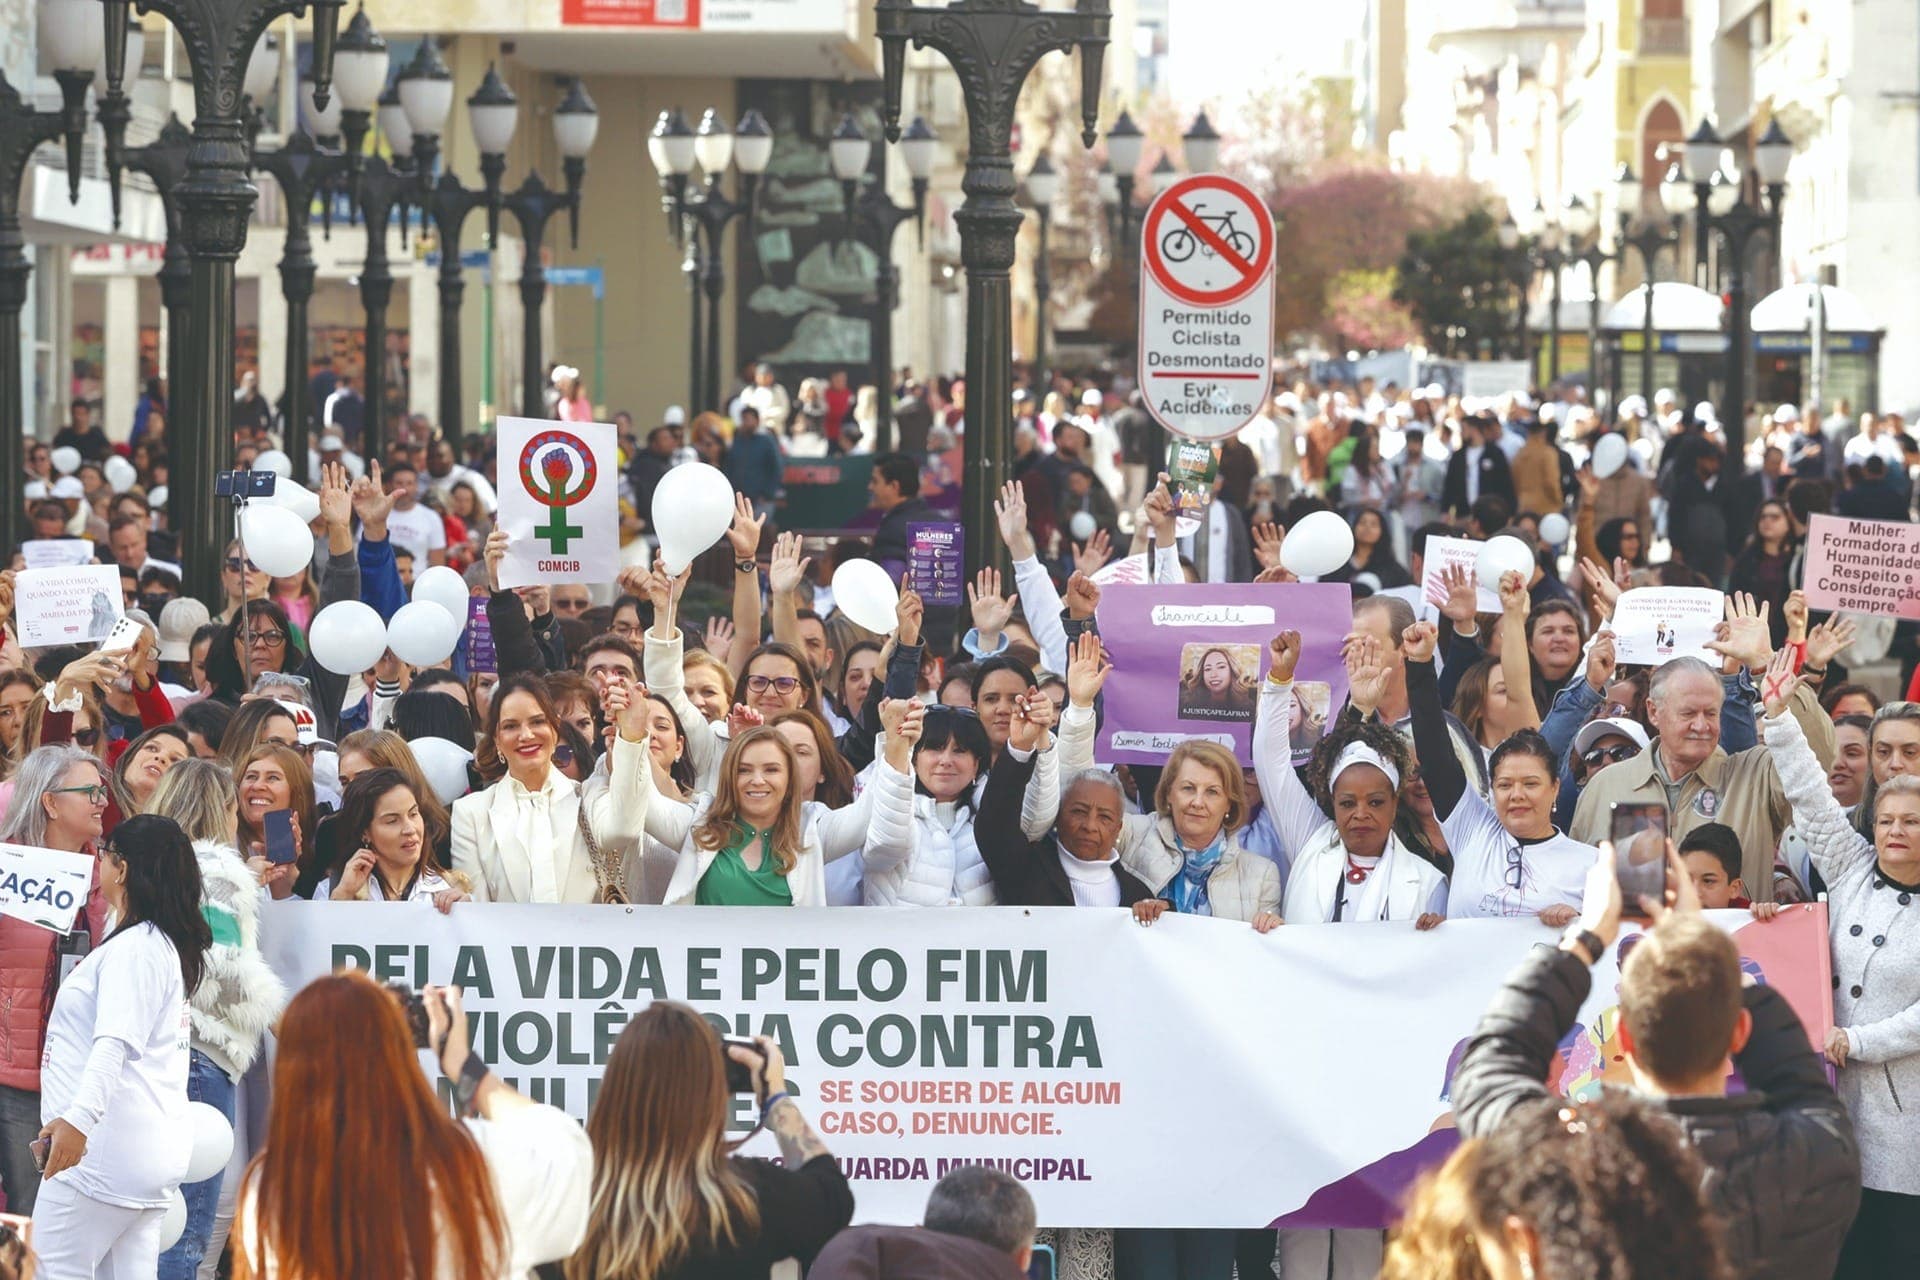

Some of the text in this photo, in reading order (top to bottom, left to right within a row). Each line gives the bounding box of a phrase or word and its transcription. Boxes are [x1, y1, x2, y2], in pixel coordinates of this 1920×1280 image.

[1163, 309, 1252, 326] Permitido
[1172, 329, 1241, 346] Ciclista
[1148, 351, 1265, 369] Desmontado
[1184, 382, 1222, 398] Evi
[915, 531, 954, 540] MULHERES
[1848, 521, 1906, 538] Mulher:
[1822, 533, 1920, 554] Formadora d
[538, 560, 580, 572] COMCIB
[1826, 548, 1920, 569] Humanidade
[1832, 564, 1913, 585] Respeito e
[27, 590, 60, 601] QUANDO
[1838, 597, 1900, 613] sempre.
[1157, 607, 1245, 624] Franciele
[511, 946, 668, 1000] VIDA
[687, 948, 721, 1001] E
[742, 947, 907, 1002] PELO
[926, 949, 1047, 1002] FIM
[816, 1013, 1103, 1068] CONTRA
[820, 1080, 1121, 1105] SE SOUBER DE ALGUM
[820, 1111, 1062, 1139] CASO, DENUNCIE.
[836, 1157, 930, 1180] UARDA
